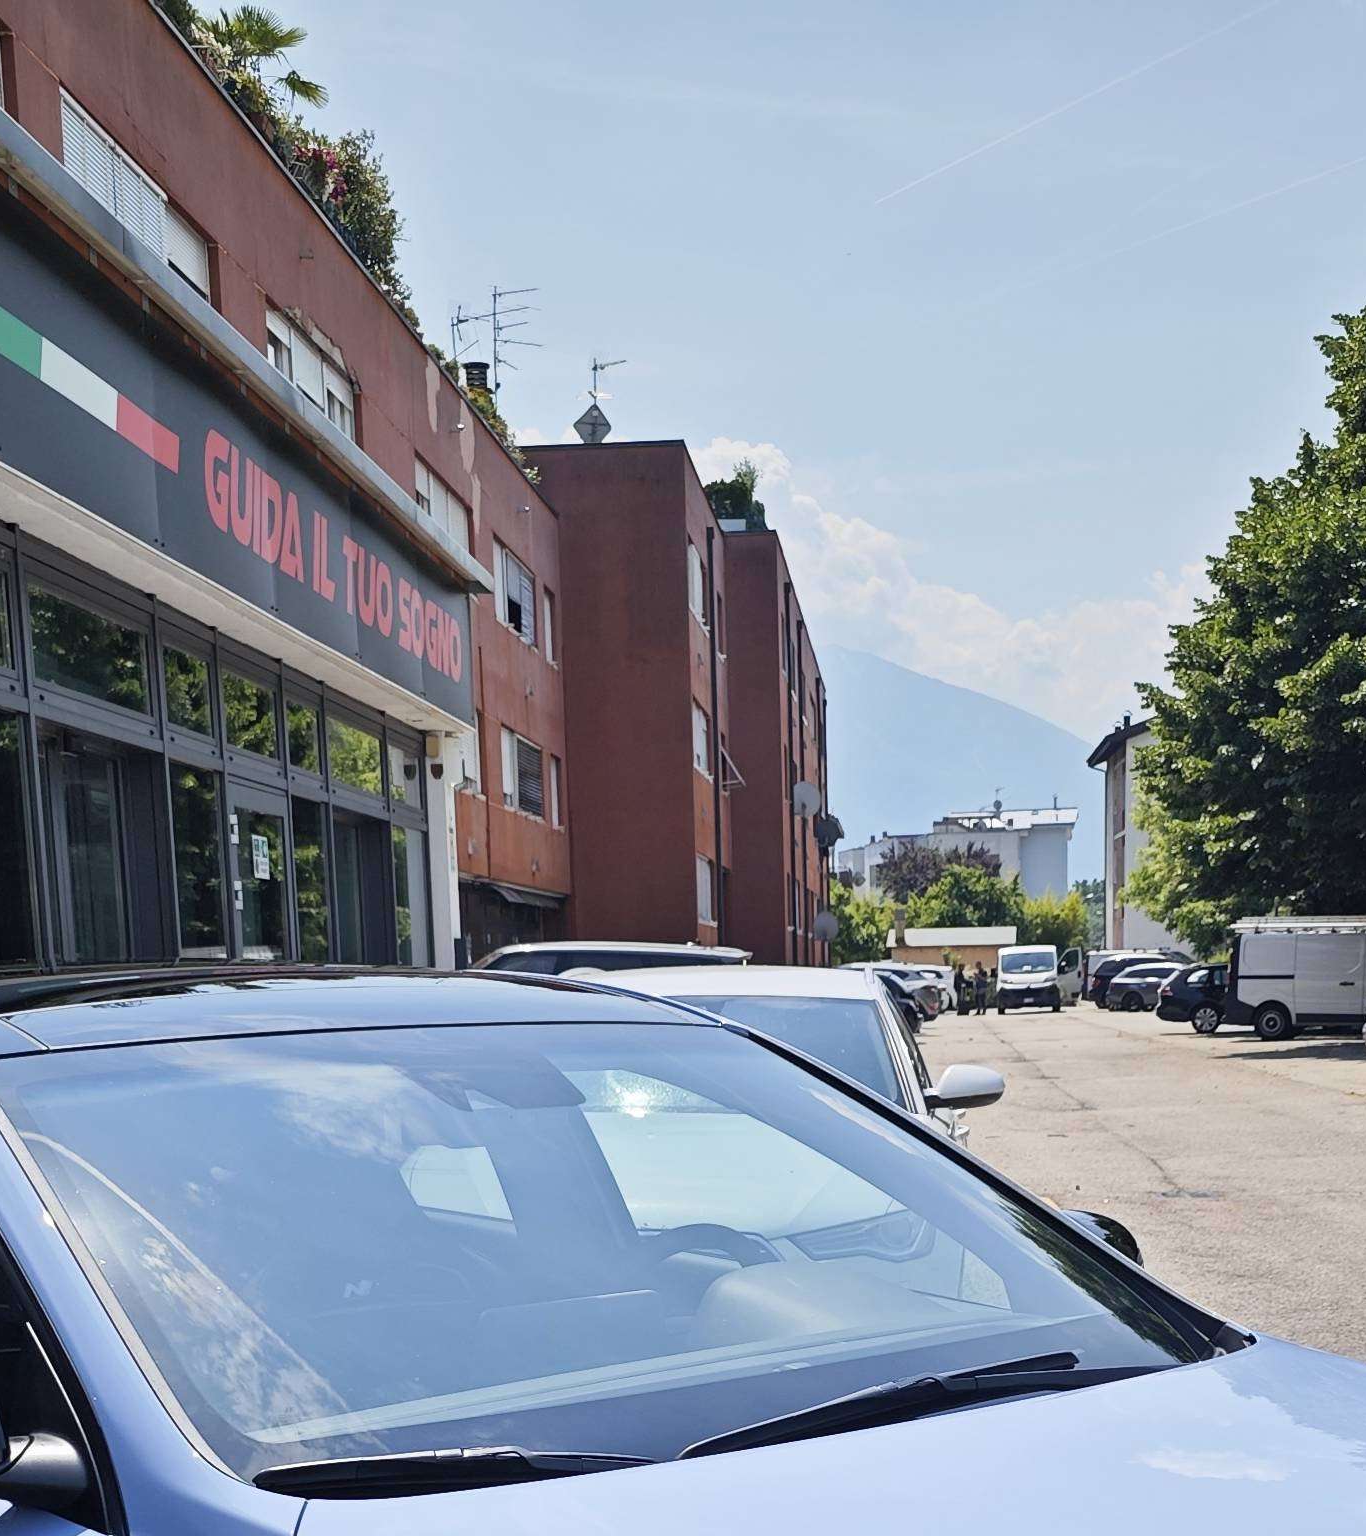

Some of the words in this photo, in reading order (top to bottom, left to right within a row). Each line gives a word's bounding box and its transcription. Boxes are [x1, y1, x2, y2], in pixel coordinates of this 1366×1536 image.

[204, 428, 305, 584] GUIDA
[313, 511, 337, 602] IL
[342, 535, 394, 638] TUO
[398, 577, 462, 684] SOGNO
